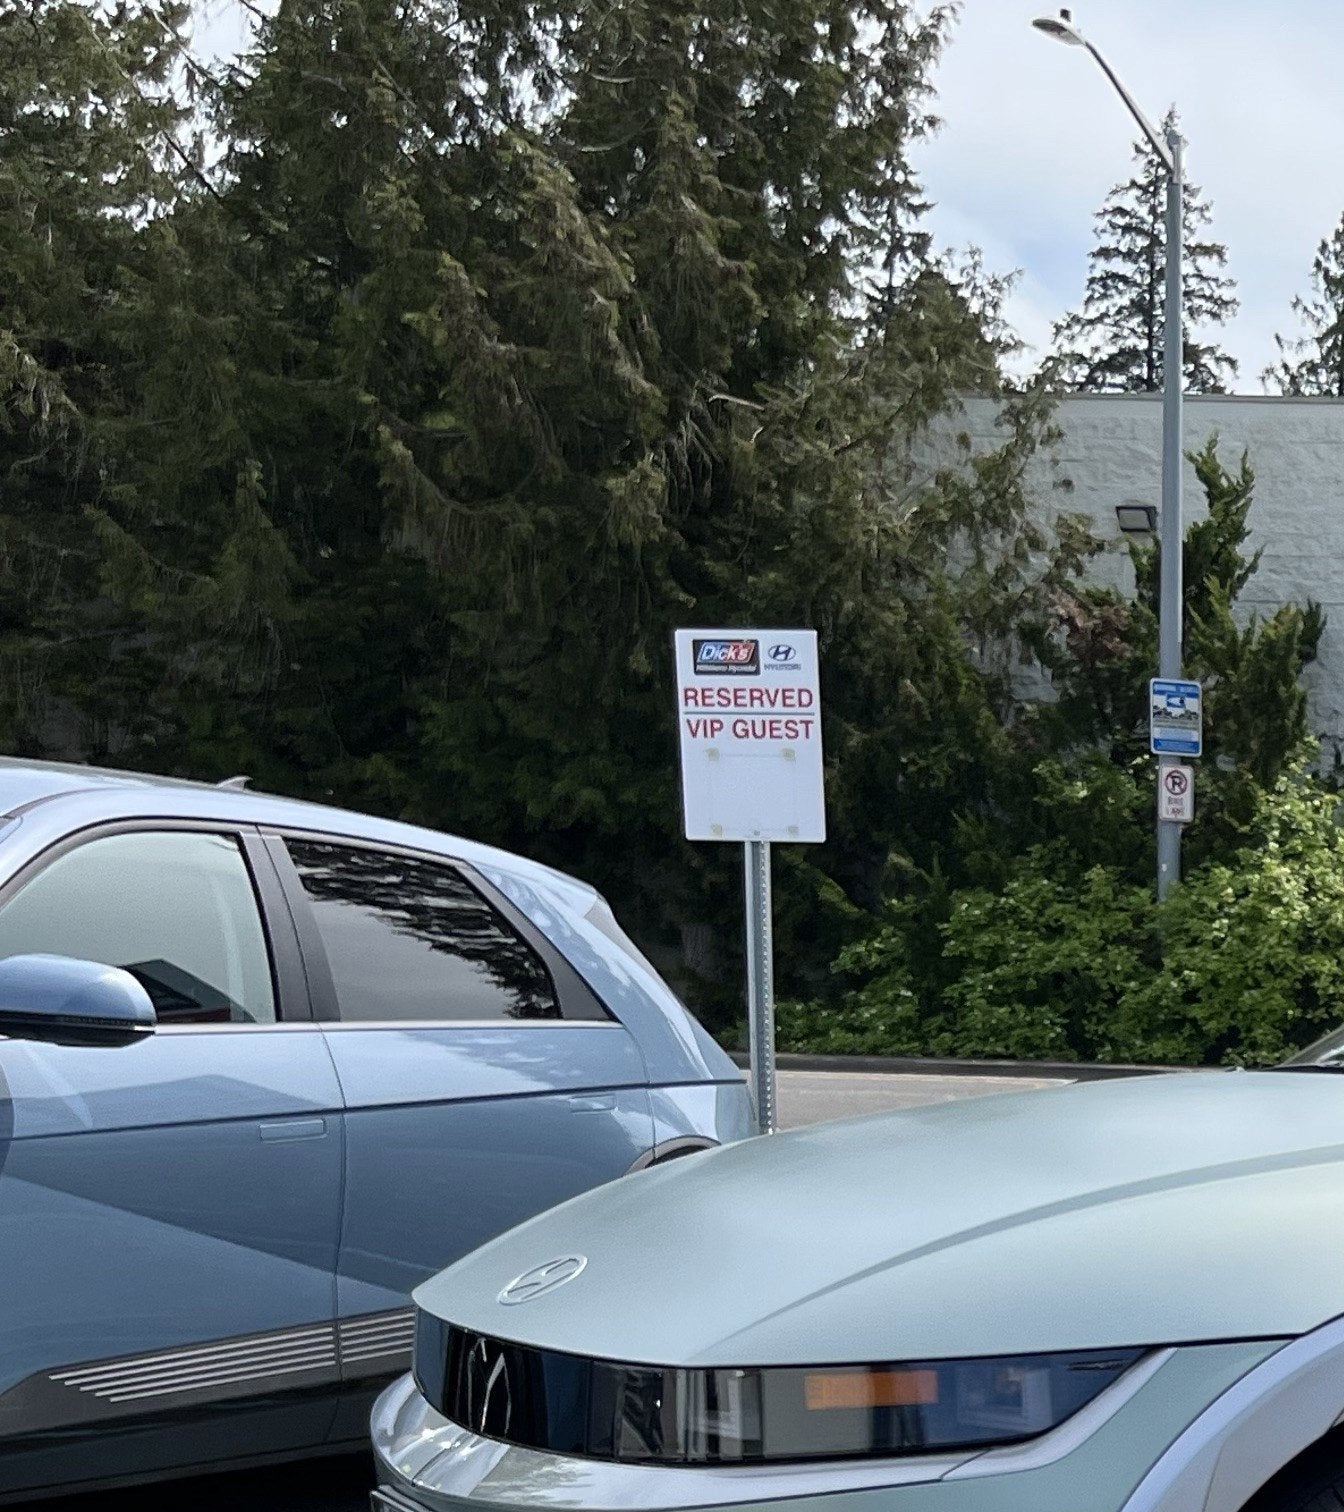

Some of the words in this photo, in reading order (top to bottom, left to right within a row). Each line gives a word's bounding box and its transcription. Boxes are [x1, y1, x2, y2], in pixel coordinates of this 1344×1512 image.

[683, 687, 813, 708] RESERVED
[686, 719, 724, 739] VIP
[732, 719, 814, 739] GUEST
